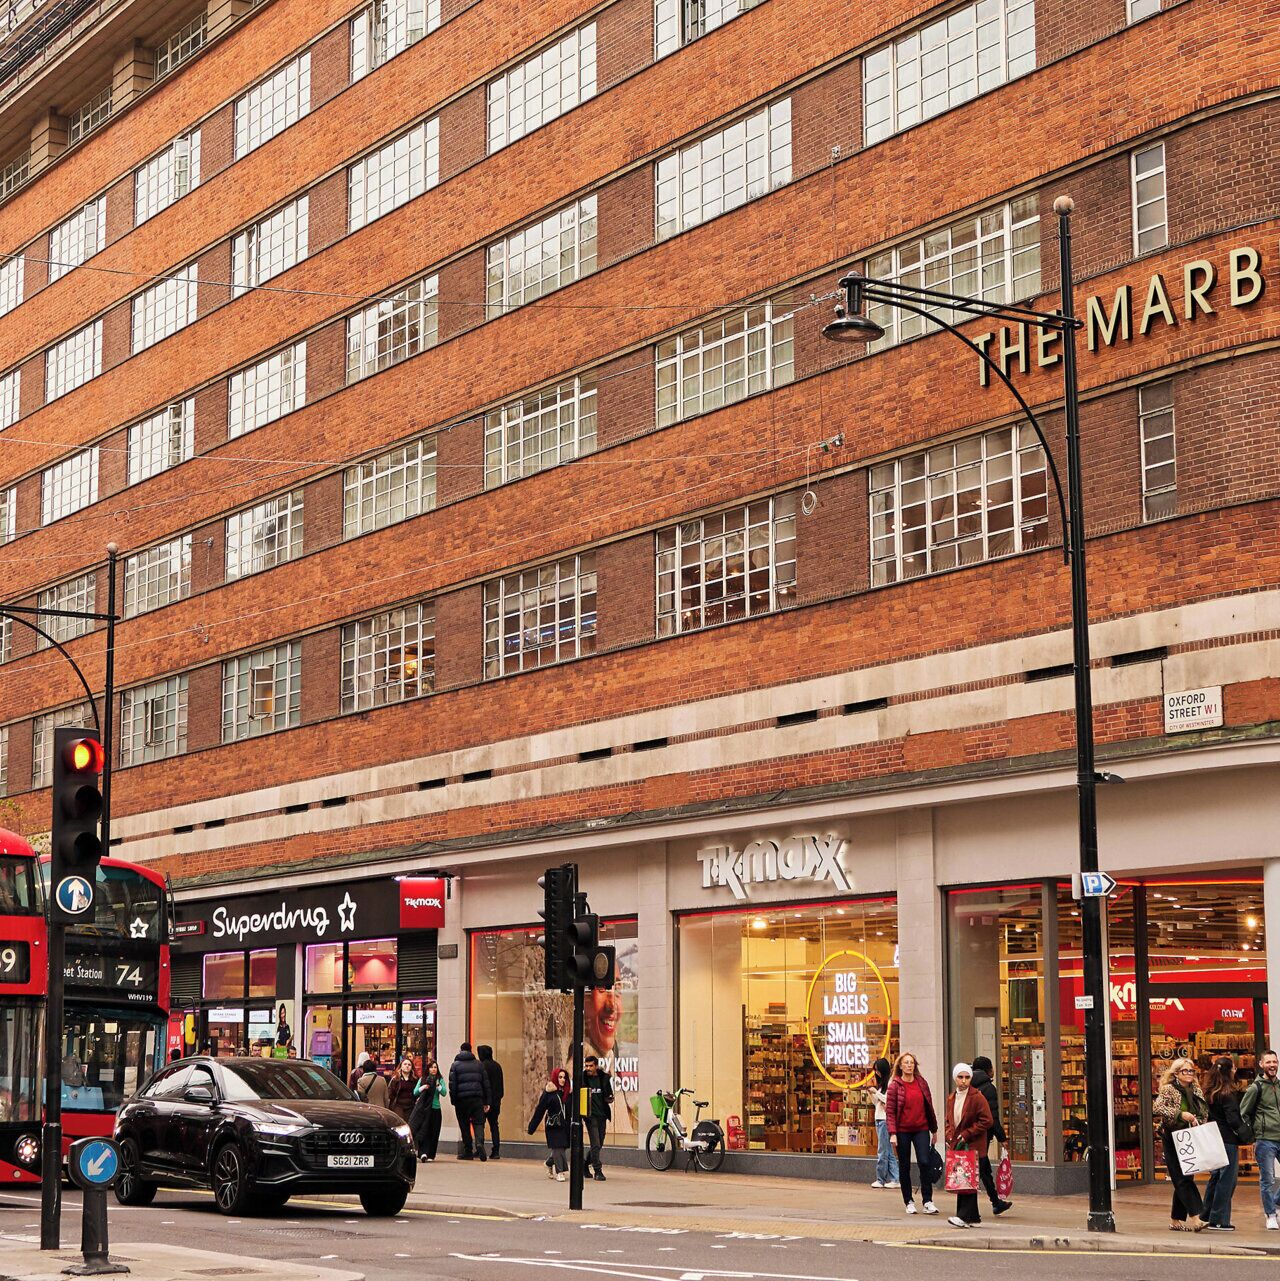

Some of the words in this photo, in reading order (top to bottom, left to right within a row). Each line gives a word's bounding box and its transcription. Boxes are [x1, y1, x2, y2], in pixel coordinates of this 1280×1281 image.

[972, 309, 1063, 386] THE
[1168, 692, 1206, 708] OXFORD
[1168, 705, 1202, 720] STREET
[1086, 876, 1099, 893] P
[212, 901, 330, 942] Superdrug
[76, 965, 103, 980] Station
[116, 964, 143, 987] 74
[835, 972, 857, 993] BIG
[127, 993, 153, 1002] WHV119
[823, 993, 869, 1015] LABELS
[827, 1022, 866, 1042] SMALL
[826, 1044, 869, 1065] PRICES
[614, 1057, 639, 1073] KNIT
[333, 1156, 352, 1166] SG21
[353, 1156, 370, 1166] ZRR
[1176, 1130, 1200, 1174] M&S
